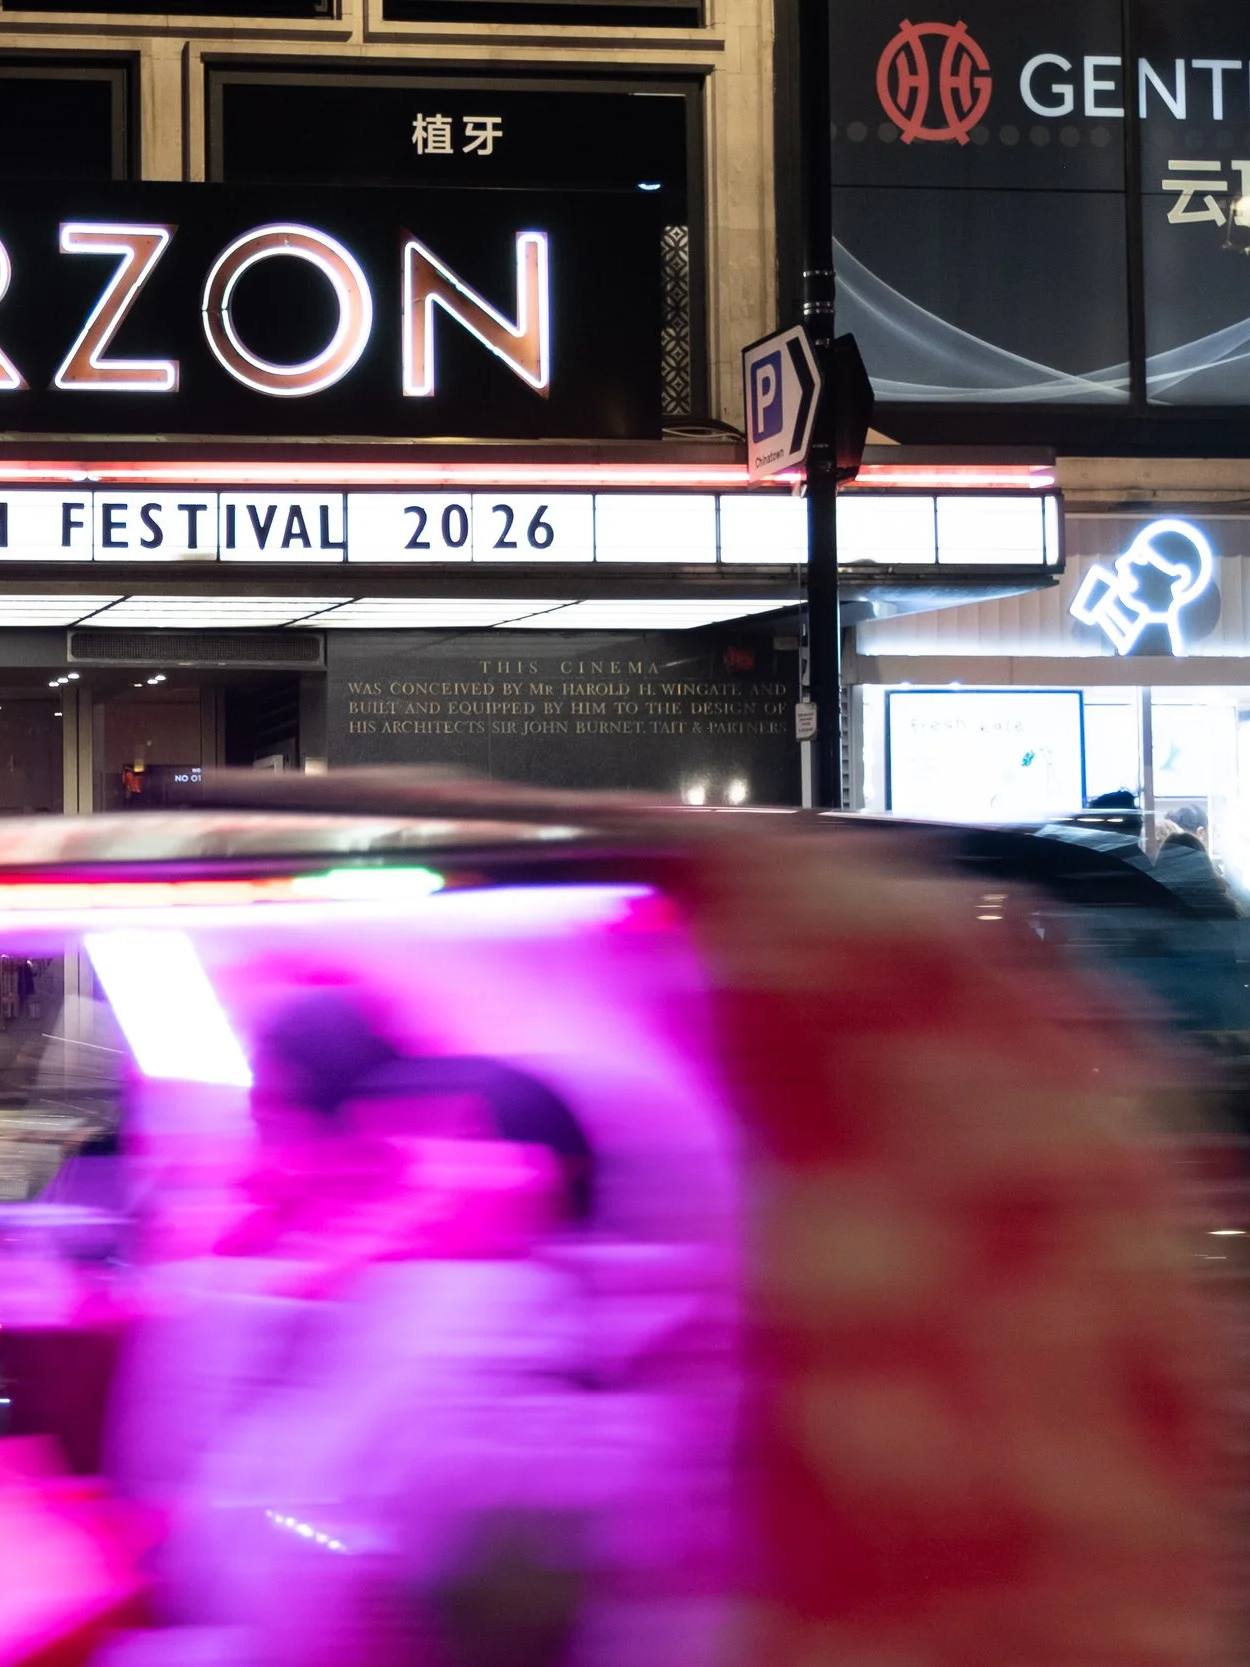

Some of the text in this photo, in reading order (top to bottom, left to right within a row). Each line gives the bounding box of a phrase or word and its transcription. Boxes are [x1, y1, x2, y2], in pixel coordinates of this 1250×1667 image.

[1019, 53, 1250, 121] GENT
[411, 112, 504, 156] 植牙
[756, 363, 776, 434] P
[755, 448, 785, 469] Chinatown
[62, 502, 347, 550] FESTIVAL
[403, 503, 556, 550] 2026
[480, 660, 660, 675] THIS CINEMA
[348, 682, 382, 696] WAS
[389, 681, 495, 696] CONCEIVED
[502, 682, 524, 696] BY
[562, 683, 630, 696] HAROLD
[751, 683, 787, 696] AND
[349, 701, 787, 716] BUILT AND EQUIPPED BY HIM TO THE DESIGN OF
[349, 720, 377, 734] HIS
[381, 720, 486, 734] ARCHITECTS
[491, 720, 518, 734] SIR
[521, 720, 568, 736] JOHN
[649, 721, 688, 734] TAIT
[692, 721, 703, 733] &
